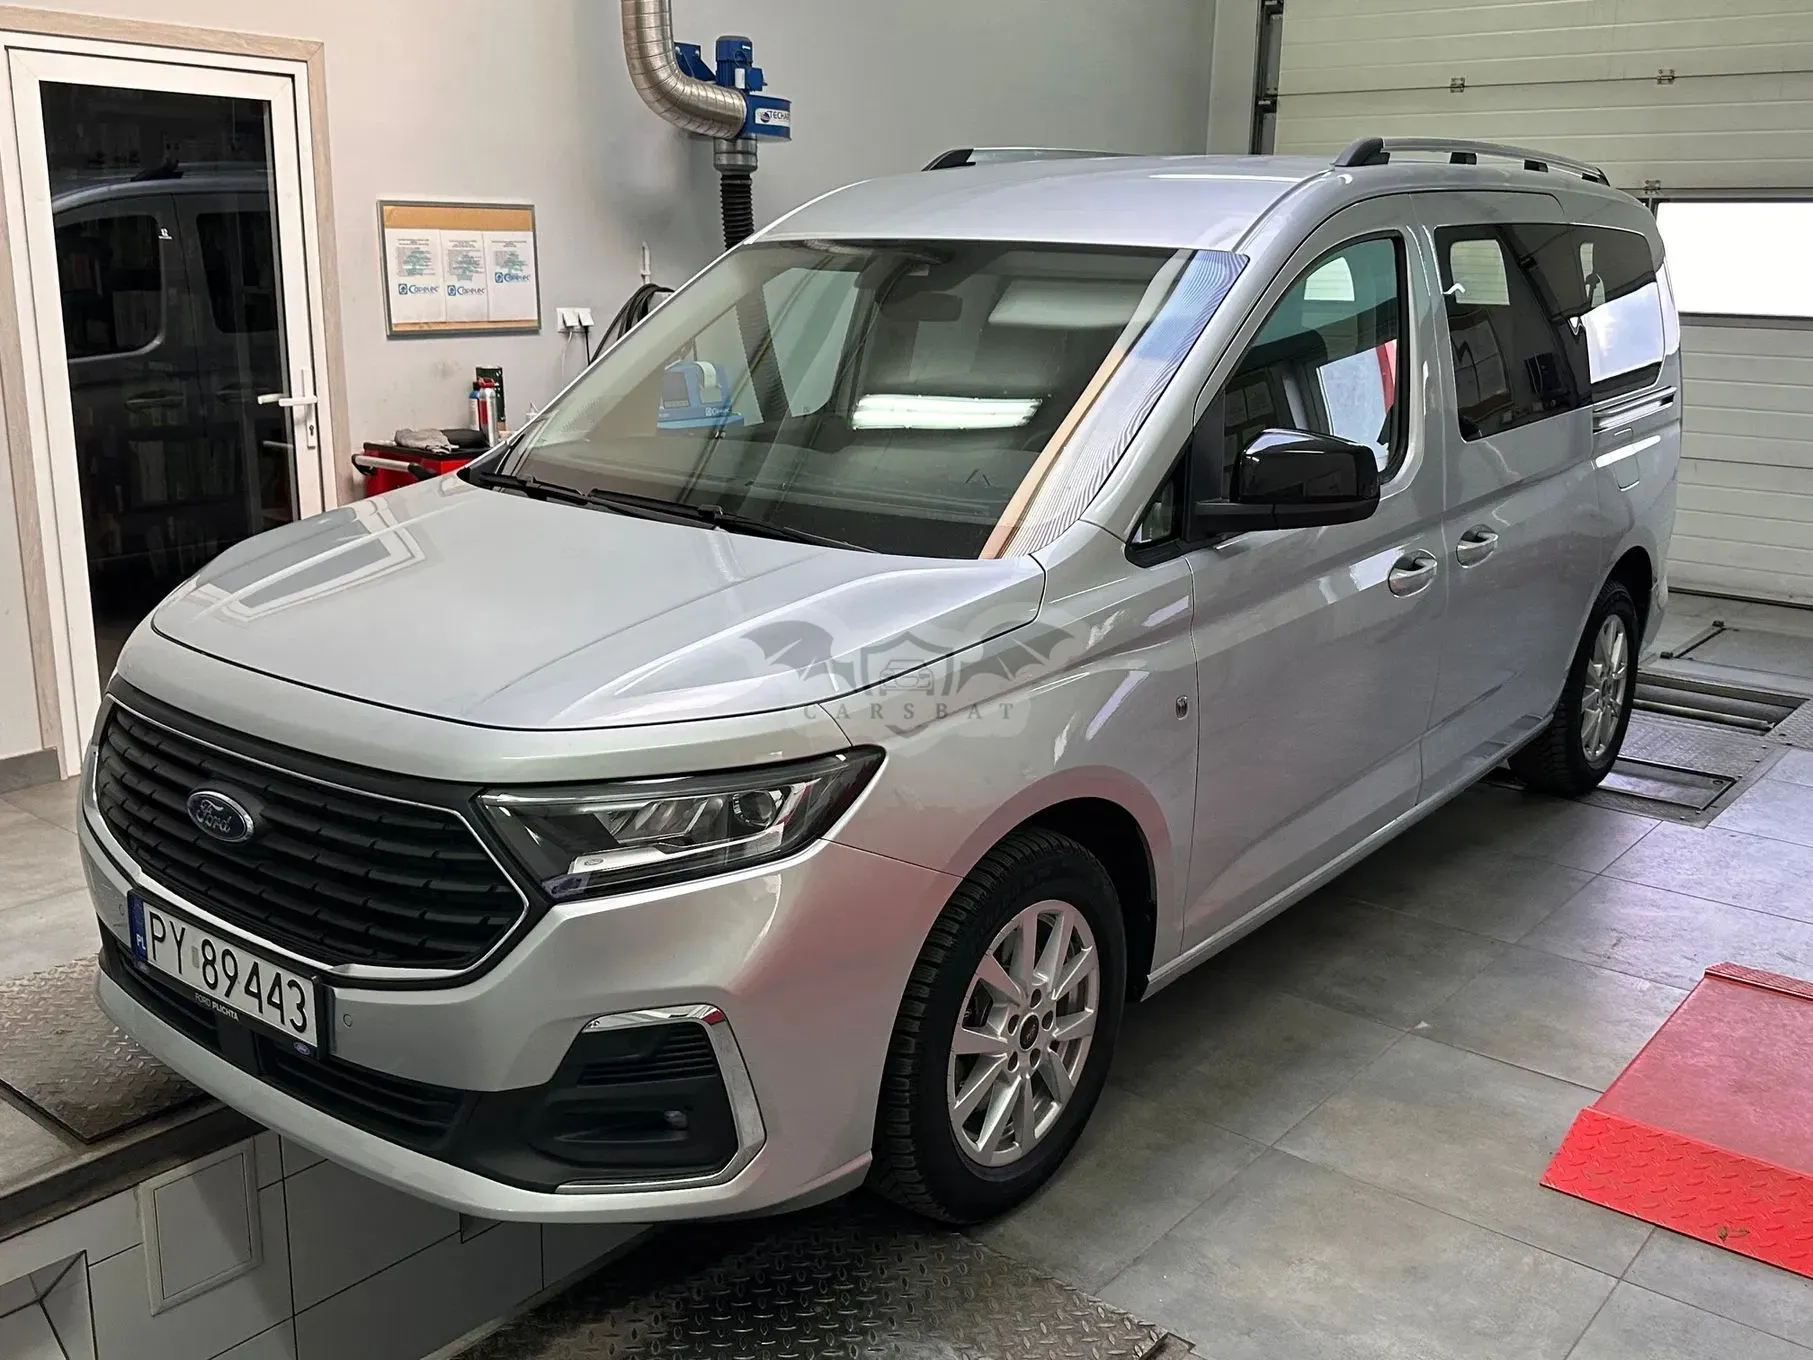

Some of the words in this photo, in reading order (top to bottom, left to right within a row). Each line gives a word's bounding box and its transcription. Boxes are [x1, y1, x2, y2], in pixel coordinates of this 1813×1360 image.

[196, 799, 235, 833] Ford
[136, 933, 147, 950] PL
[149, 910, 186, 975] PY
[201, 938, 308, 1034] 89443
